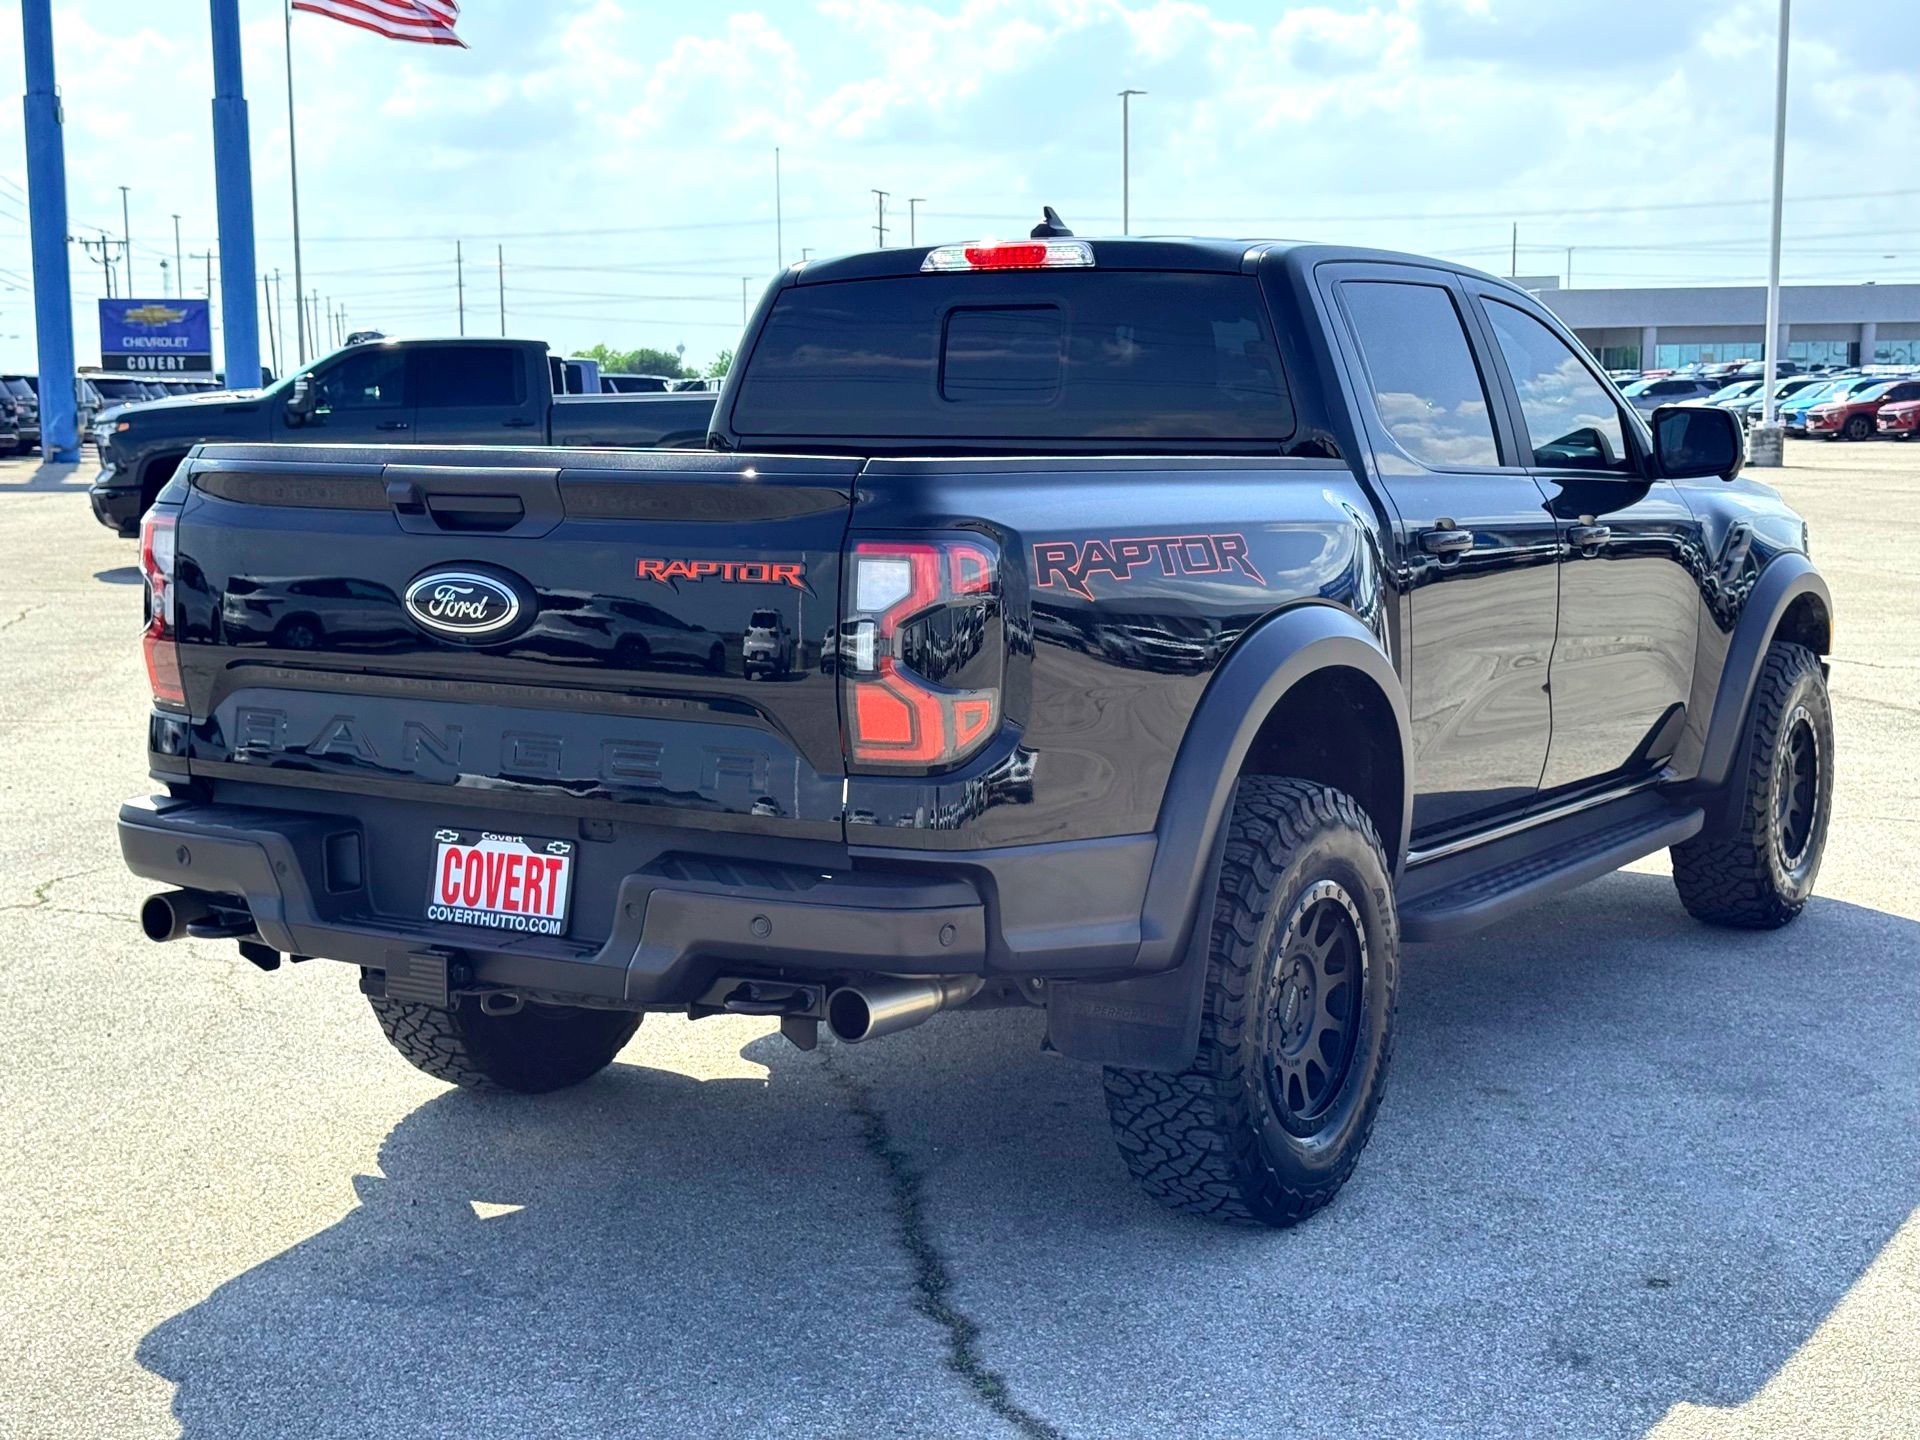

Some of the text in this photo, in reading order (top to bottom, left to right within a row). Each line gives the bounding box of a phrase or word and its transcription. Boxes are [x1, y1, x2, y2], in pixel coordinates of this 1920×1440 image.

[122, 336, 189, 348] CHEVROLET
[126, 356, 186, 370] COVERT
[636, 557, 818, 600] RAPTOR
[1033, 533, 1267, 602] RAPTOR
[428, 584, 488, 619] Ford
[233, 705, 771, 793] RANGER
[481, 831, 525, 843] Covert
[441, 847, 563, 916] COVERT
[427, 905, 561, 935] COVERTHUTTO.COM
